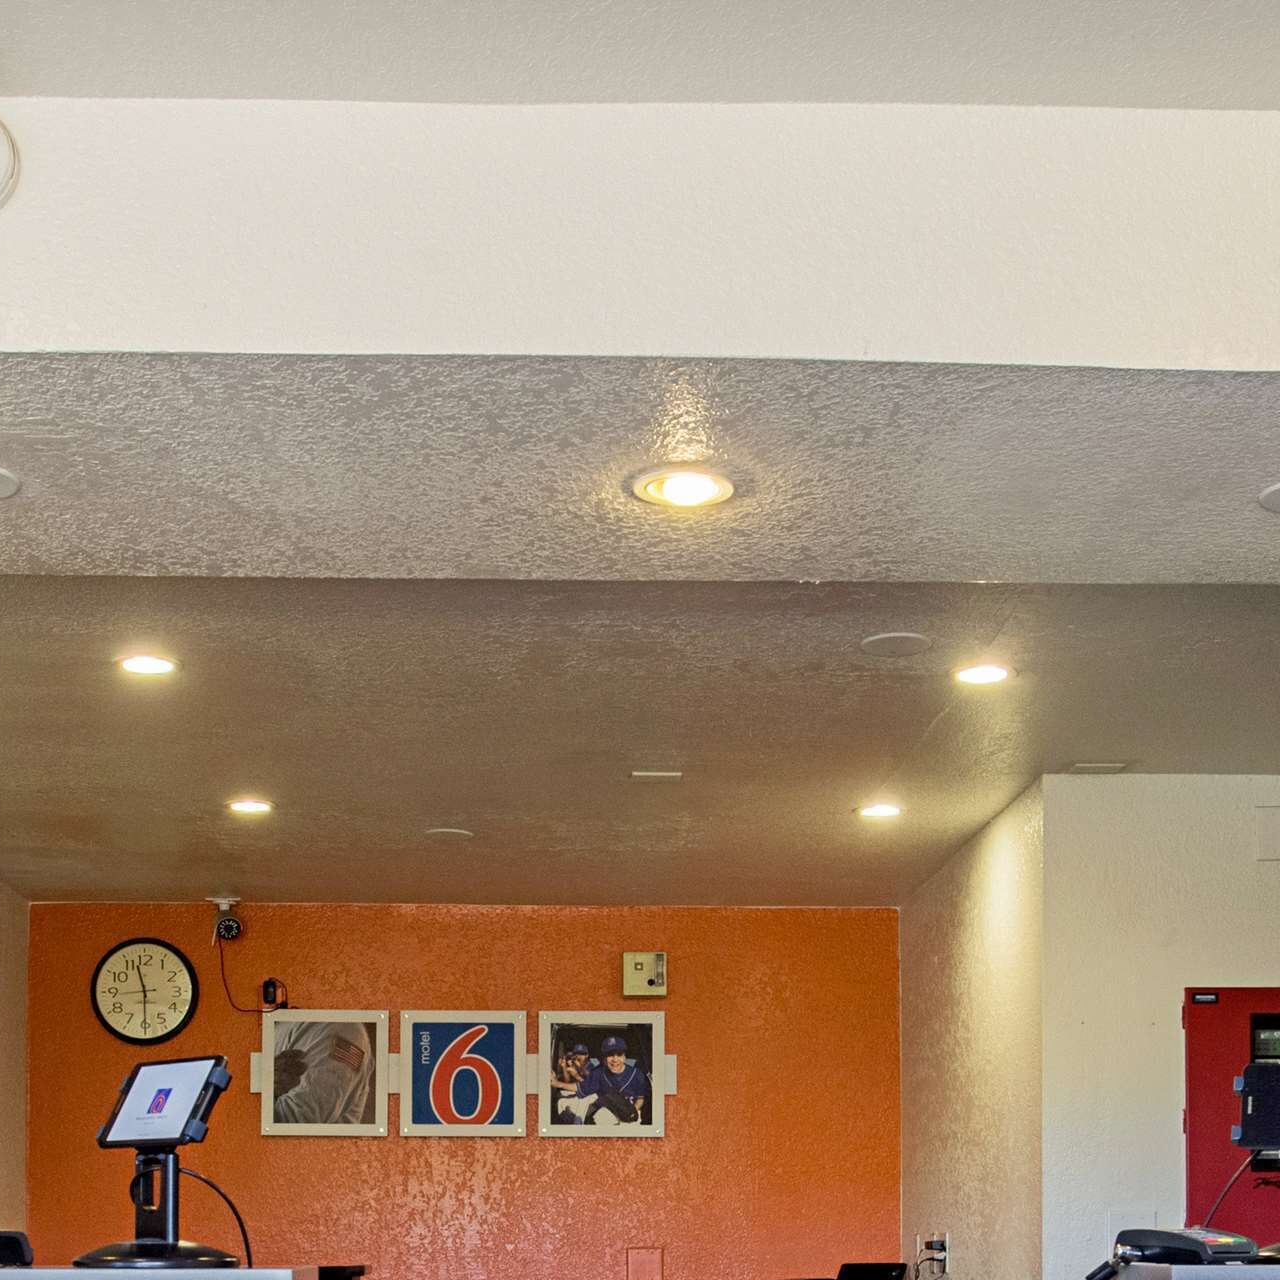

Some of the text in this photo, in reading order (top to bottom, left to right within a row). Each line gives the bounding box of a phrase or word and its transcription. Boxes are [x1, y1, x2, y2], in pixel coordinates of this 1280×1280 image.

[125, 959, 135, 971] 11
[138, 954, 153, 966] 12
[160, 959, 164, 970] 1
[113, 971, 128, 983] 10
[167, 971, 177, 982] 2
[108, 987, 118, 998] 9
[172, 986, 182, 998] 3
[112, 1002, 123, 1013] 8
[168, 1002, 177, 1012] 4
[125, 1013, 134, 1024] 7
[156, 1013, 166, 1024] 5
[420, 1031, 430, 1065] motel
[429, 1024, 502, 1125] 6
